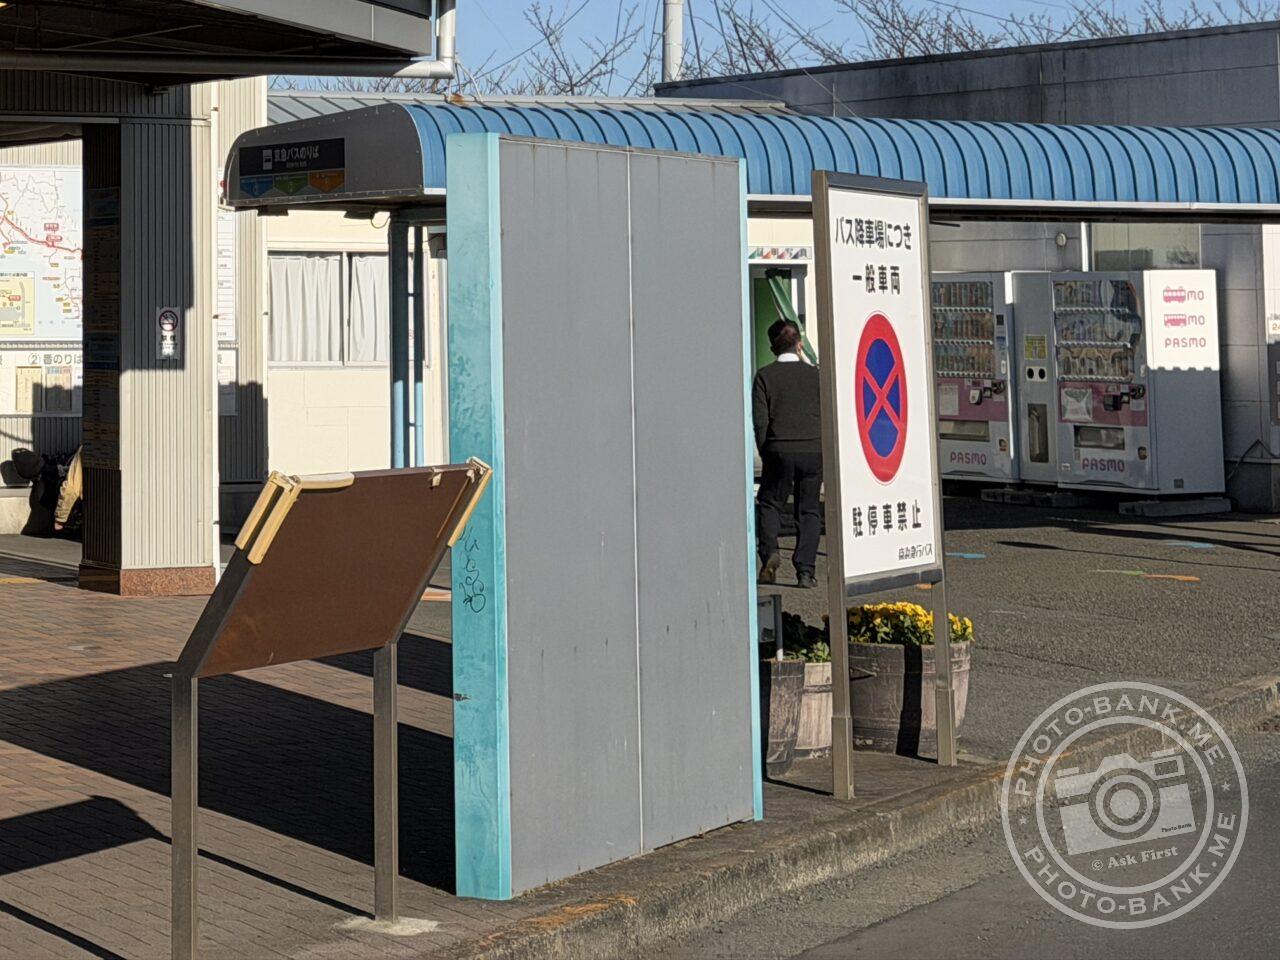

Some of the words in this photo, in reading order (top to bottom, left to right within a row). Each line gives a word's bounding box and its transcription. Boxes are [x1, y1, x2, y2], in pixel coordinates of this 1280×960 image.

[835, 217, 911, 250] バス降車場につき
[852, 264, 901, 295] 一般車両
[1165, 338, 1207, 349] PASMO
[950, 451, 987, 466] PASMO
[1082, 457, 1125, 472] PASMO
[852, 499, 921, 537] 駐停車禁止
